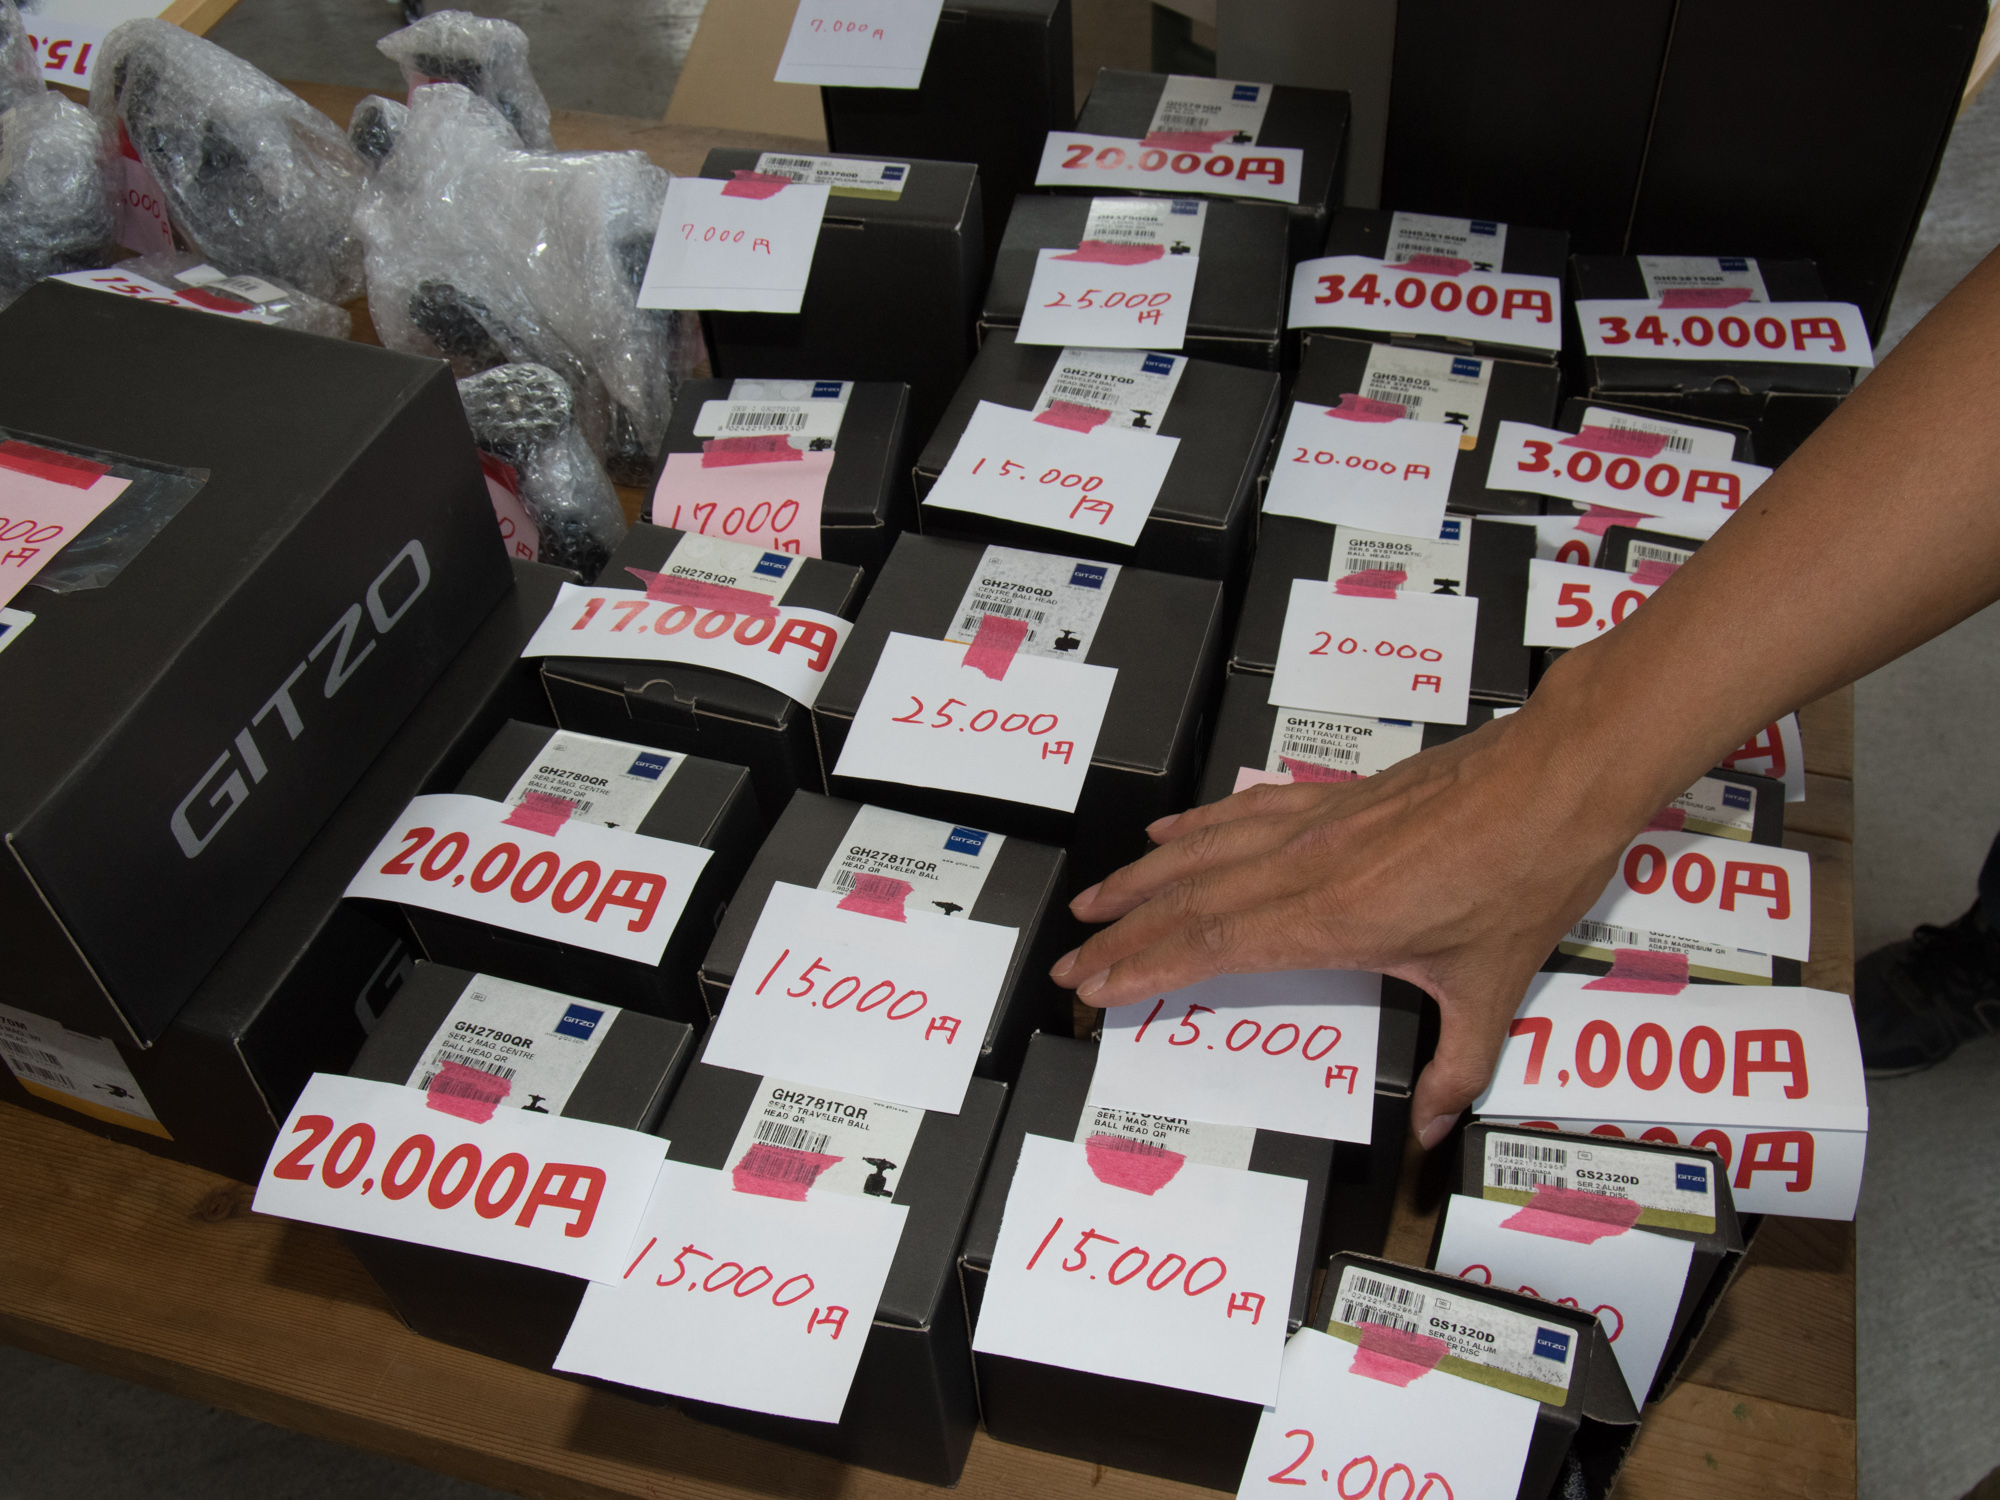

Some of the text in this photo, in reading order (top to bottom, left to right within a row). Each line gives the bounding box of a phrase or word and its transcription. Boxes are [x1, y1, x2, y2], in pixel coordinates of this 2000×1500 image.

[1314, 273, 1554, 324] 34,000円
[1599, 315, 1846, 353] 34,000円
[1062, 367, 1135, 385] GH2781TQD
[1372, 372, 1431, 387] GH5380S
[1517, 439, 1741, 510] 3,000円
[1349, 538, 1413, 552] GH5380S
[1373, 548, 1422, 558] SYSTEMATIC
[760, 560, 787, 570] GITZO
[672, 565, 737, 586] GH2781QR
[1075, 571, 1103, 581] GITZO
[978, 586, 1058, 606] CENTRE BALL HEAD
[981, 578, 1053, 597] GH2780QD
[170, 539, 431, 859] GITZO
[1287, 717, 1373, 737] GH1781TQR
[1312, 730, 1358, 742] TRAVELER
[1284, 733, 1319, 744] CENTRE
[1320, 739, 1343, 747] BALL
[635, 760, 663, 771] GITZO
[538, 765, 609, 787] GH2780QR
[528, 781, 587, 798] BALL HEAD QR
[580, 784, 611, 796] CENTRE
[951, 834, 982, 846] GITZO
[841, 860, 881, 875] HEAD QR
[845, 854, 940, 881] SER.2 TRAVELER BALL
[849, 845, 938, 873] GH2781TQR
[380, 827, 667, 933] 20,000円
[1648, 944, 1681, 954] ADAPTER
[1671, 941, 1713, 953] MAGNESIUM
[563, 1015, 595, 1028] GITZO
[454, 1021, 534, 1050] GH2780QR
[442, 1040, 509, 1064] BALL HEAD QR
[447, 1031, 473, 1044] SER.2
[499, 1045, 537, 1061] CENTRE
[1509, 1016, 1809, 1100] 7,000円
[772, 1088, 868, 1121] GH2781TQR
[763, 1108, 806, 1125] HEAD QR
[796, 1106, 845, 1125] TRAVELER
[847, 1118, 871, 1132] BALL
[1096, 1111, 1122, 1122] SER.1
[1125, 1115, 1149, 1128] MAG.
[1153, 1121, 1191, 1136] CENTRE
[1094, 1118, 1167, 1139] BALL HEAD QR
[273, 1114, 607, 1238] 20,000円
[1576, 1169, 1640, 1185] GS2320D
[1677, 1173, 1706, 1183] GITZO
[1609, 1191, 1629, 1200] DISC
[1364, 1304, 1378, 1313] AND
[1378, 1308, 1404, 1320] CANADA
[1429, 1317, 1495, 1343] GS1320D
[1459, 1346, 1481, 1358] DISC
[1537, 1338, 1566, 1352] GITZO
